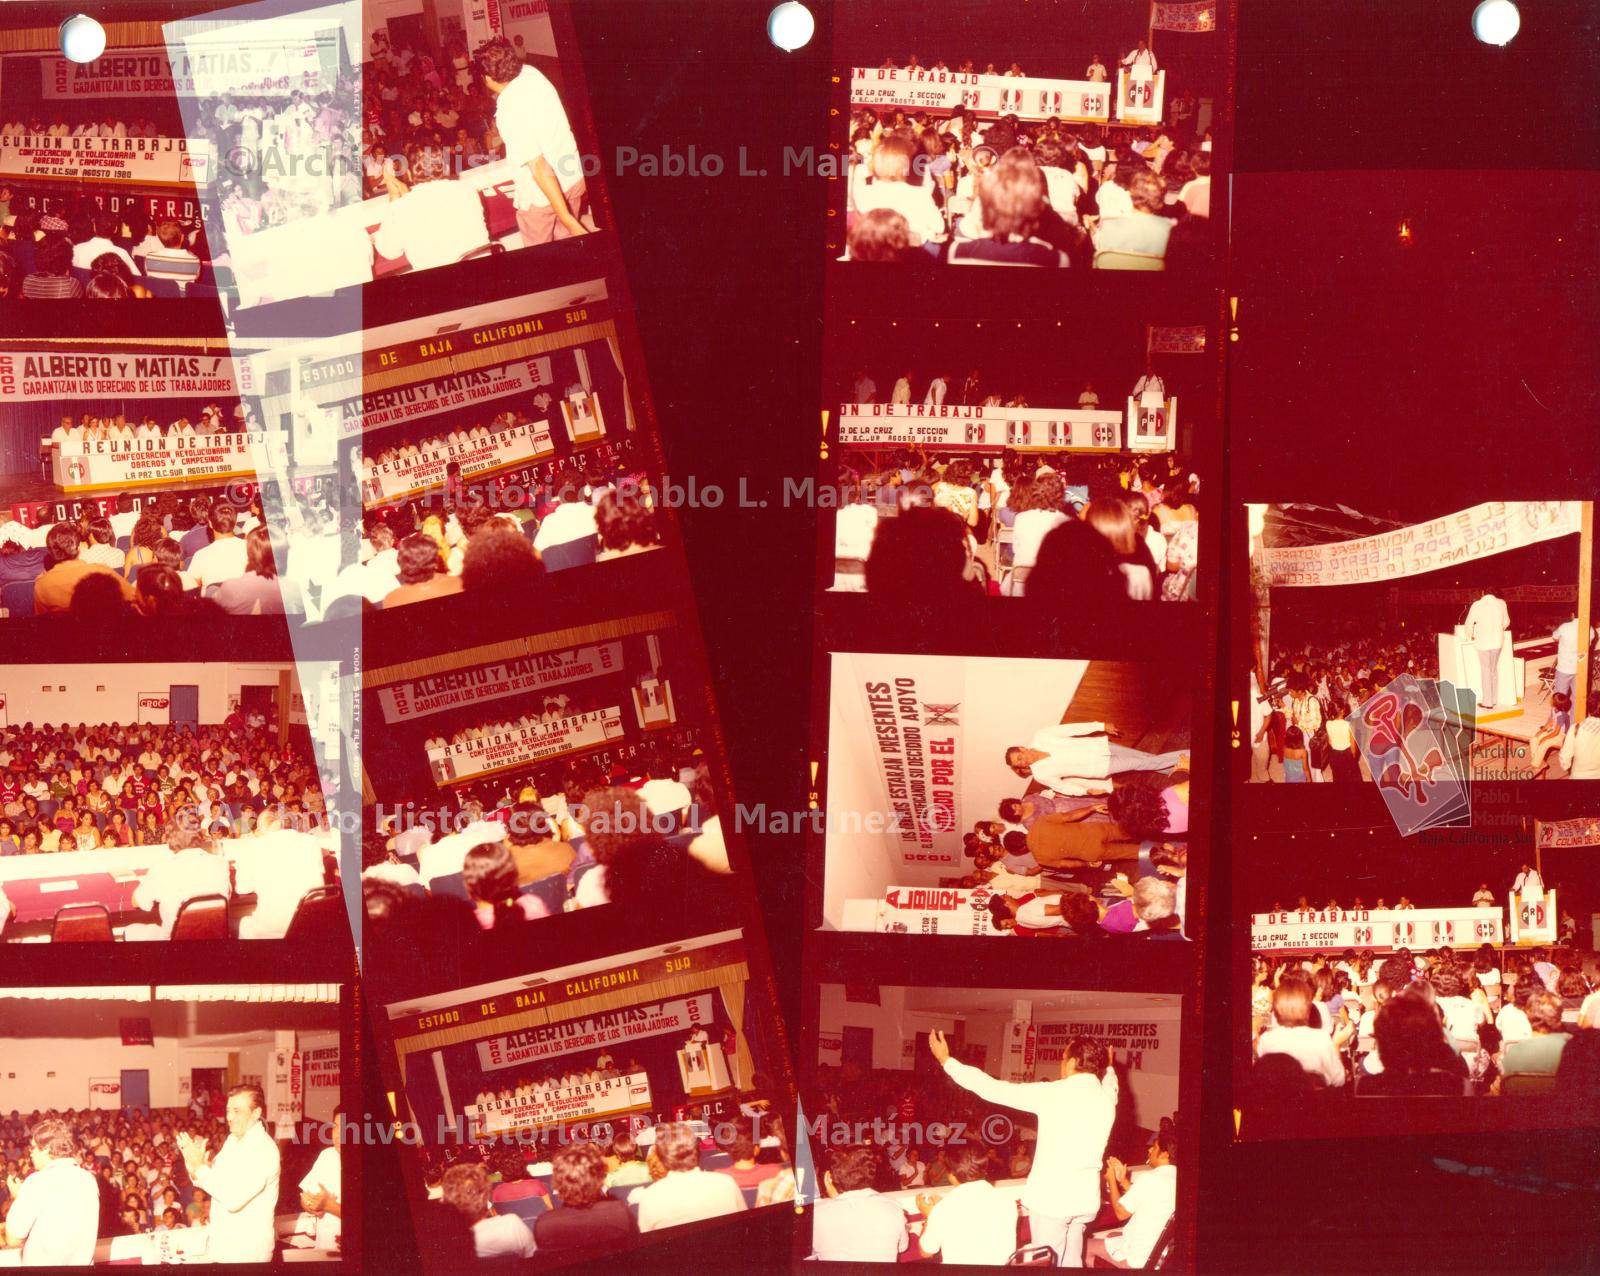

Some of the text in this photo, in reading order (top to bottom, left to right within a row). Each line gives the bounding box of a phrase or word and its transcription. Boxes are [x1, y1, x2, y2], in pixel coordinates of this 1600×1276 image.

[75, 57, 160, 79] ALBERTO
[878, 69, 978, 85] DE TRABAJO
[73, 80, 124, 94] GARANTIZAN
[126, 79, 141, 92] LOS
[1129, 83, 1151, 100] PRI
[73, 138, 92, 149] DE
[101, 139, 188, 152] TRABAJO
[19, 149, 155, 161] CONFEDERACION REVOLUCIONARIA DE
[33, 157, 125, 168] OBREROS CAMPESINOS
[82, 169, 110, 178] AGOSTO
[24, 356, 112, 378] ALBERTO
[118, 362, 128, 378] Y
[302, 361, 354, 383] ESTADO
[380, 351, 398, 366] DE
[420, 340, 452, 357] BAJA
[23, 379, 232, 395] GARANTIZAN LOS DERECHOS DE LOS TRABAJADORES
[344, 378, 522, 432] GARANTIZAN LOS DERECHOS DE LOS TRABAJADORES
[874, 404, 983, 418] DE TRABAJO
[1141, 414, 1162, 428] PRI
[874, 427, 893, 435] CRUZ
[917, 427, 948, 435] SECCION
[83, 437, 166, 454] REUNION
[178, 436, 196, 449] DE
[372, 451, 441, 477] REUNION
[449, 442, 465, 456] DE
[472, 424, 536, 450] TRABAJO
[111, 450, 172, 462] CONFEDERACION
[175, 448, 231, 458] REVOLUCIONARIA
[131, 456, 224, 469] OBREROS CAMPESINOS
[125, 465, 232, 480] LA PAZ AGOSTO 1980
[397, 458, 447, 478] CONFEDERACION
[414, 468, 443, 480] OBREROS
[419, 477, 434, 488] PAZ
[415, 663, 593, 713] GARANTIZAN LOS DERECHOS DE LOS TRABAJADORES
[140, 698, 168, 708] CROC
[353, 686, 361, 721] SAFETY
[895, 677, 918, 721] APOYO
[866, 682, 902, 754] PRESENTES
[444, 732, 511, 757] REUNION
[521, 727, 537, 739] DE
[544, 710, 608, 736] TRABAJO
[469, 741, 518, 758] CONFEDERACION
[486, 738, 564, 760] OBREROS CAMPESINOS
[903, 727, 923, 767] DECIDIDO
[930, 737, 955, 755] EL
[883, 757, 907, 799] ESTARAN
[909, 767, 924, 778] SU
[931, 758, 954, 786] POR
[904, 853, 952, 862] CROC
[886, 889, 967, 911] ALBERT
[1269, 911, 1369, 925] DE TRABAJO
[1521, 907, 1543, 921] PRI
[1310, 932, 1339, 940] SECCION
[419, 1011, 460, 1030] ESTADO
[481, 1003, 496, 1017] DE
[516, 992, 545, 1008] BAJA
[507, 1021, 576, 1051] ALBERTO
[1107, 1023, 1158, 1036] PRESENTES
[506, 1015, 680, 1063] GARANTIZAN LOS DERECHOS DE LOS TRABAJADORES
[1130, 1038, 1159, 1050] APOYO
[477, 1076, 633, 1113] REUNION DE TRABAJO
[500, 1101, 545, 1116] CONFEDERACION
[551, 1101, 589, 1113] CAMPESINOS
